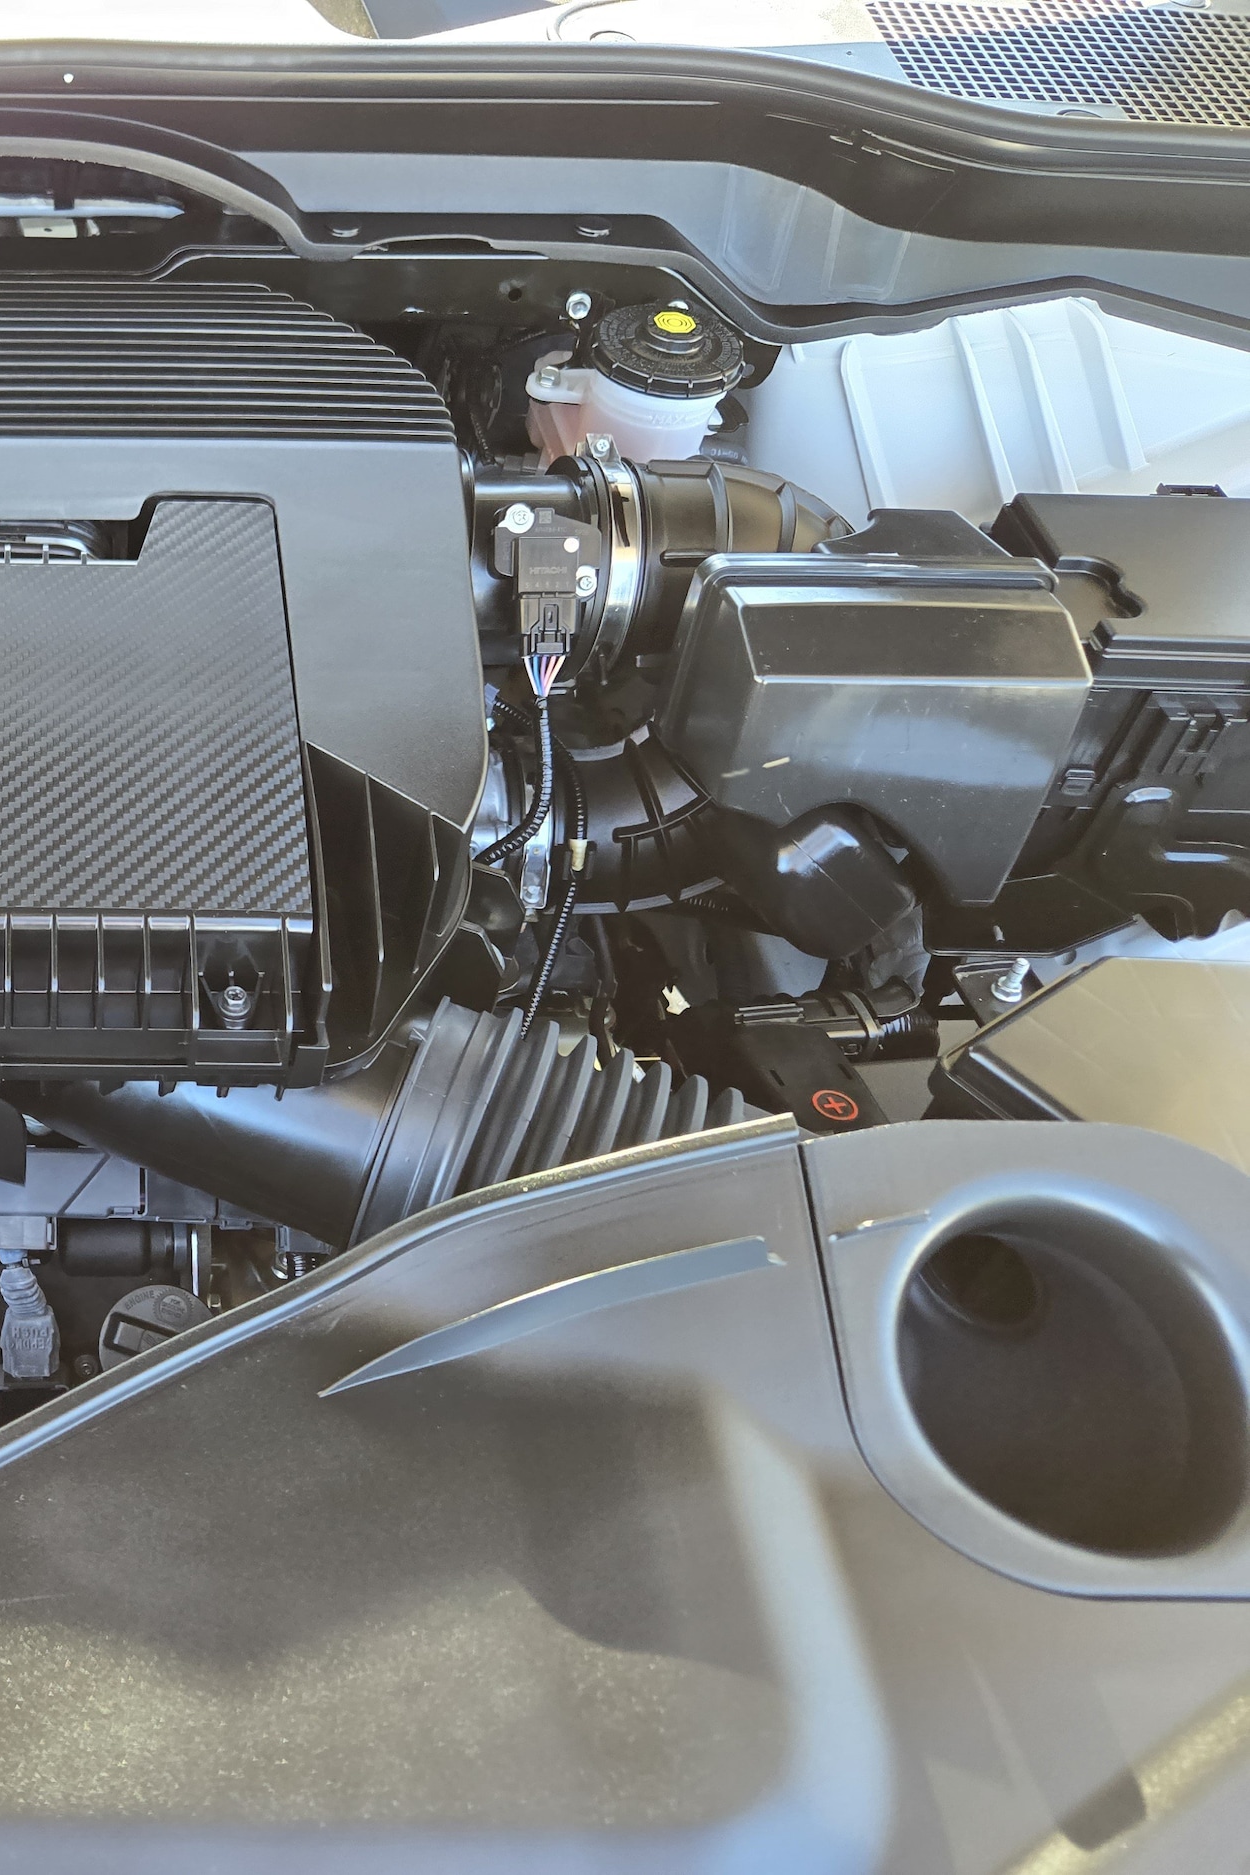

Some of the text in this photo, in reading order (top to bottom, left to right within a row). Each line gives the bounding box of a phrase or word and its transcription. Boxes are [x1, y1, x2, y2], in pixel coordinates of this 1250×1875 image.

[652, 414, 685, 425] MAX
[529, 566, 569, 575] HITACHI
[124, 1289, 156, 1311] ENGINE
[12, 1326, 49, 1339] PUSH
